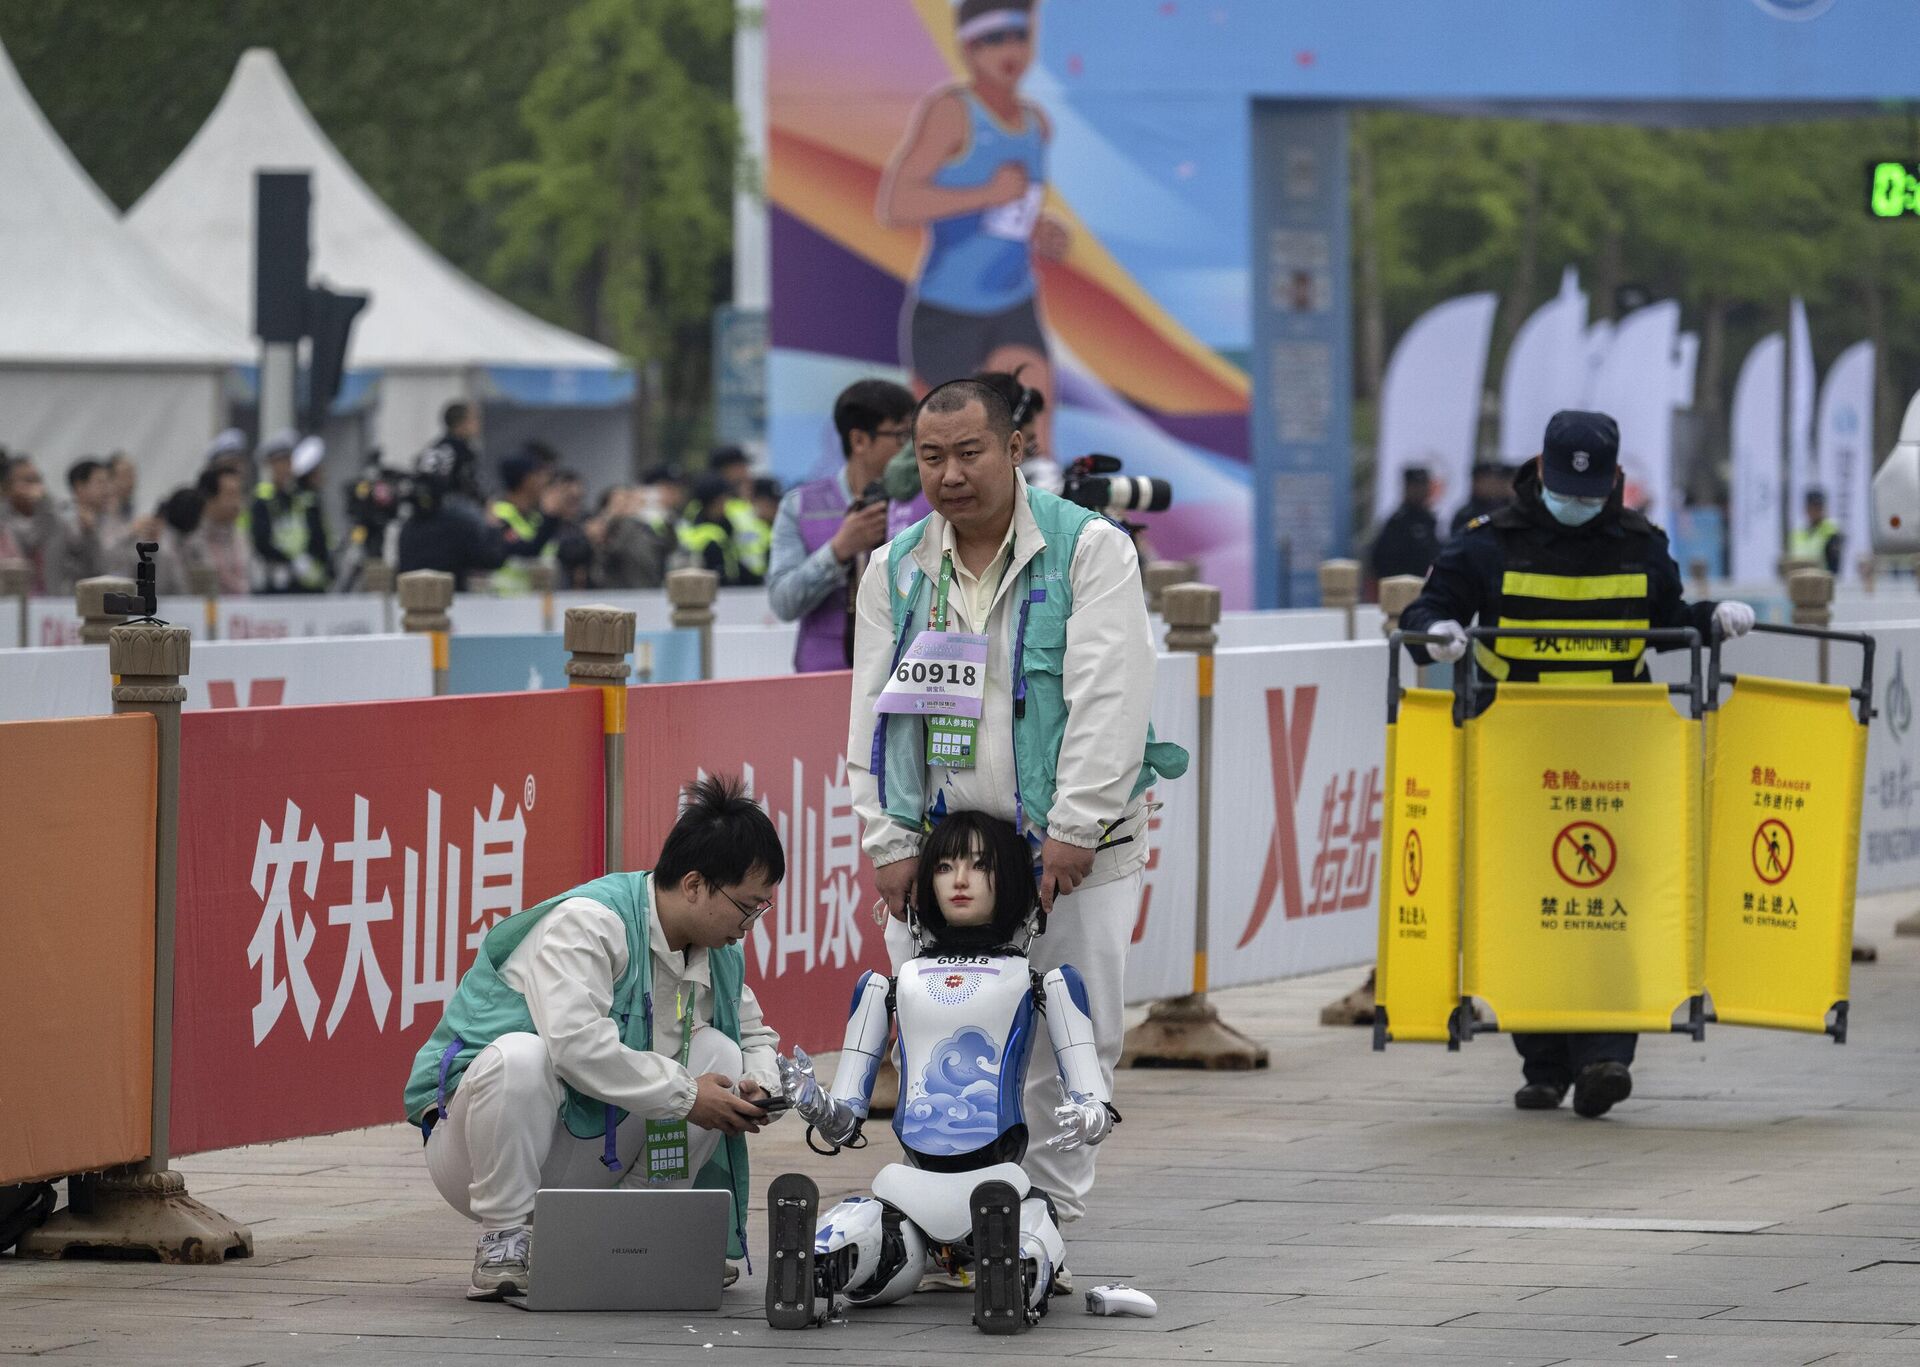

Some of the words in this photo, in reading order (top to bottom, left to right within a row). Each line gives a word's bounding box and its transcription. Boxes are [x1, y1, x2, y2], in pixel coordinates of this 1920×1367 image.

[896, 662, 976, 687] 60918
[931, 717, 975, 729] 机器人参赛队
[1542, 769, 1581, 790] 危险
[1582, 781, 1630, 792] DANGER
[1751, 765, 1777, 787] 危险
[1777, 778, 1811, 791] DANGER
[1550, 796, 1623, 812] 工作进行中
[1753, 792, 1804, 811] 工作进行中
[1306, 766, 1382, 918] 特步
[1541, 897, 1628, 917] 禁止进入
[1743, 892, 1798, 915] 禁止进入
[247, 783, 527, 1048] 农夫山泉
[1743, 916, 1753, 925] NO
[1757, 916, 1797, 930] ENTRANCE
[1541, 920, 1557, 930] NO
[1564, 920, 1627, 931] ENTRANCE
[937, 955, 989, 965] 60918
[612, 1247, 648, 1255] HUAWEI
